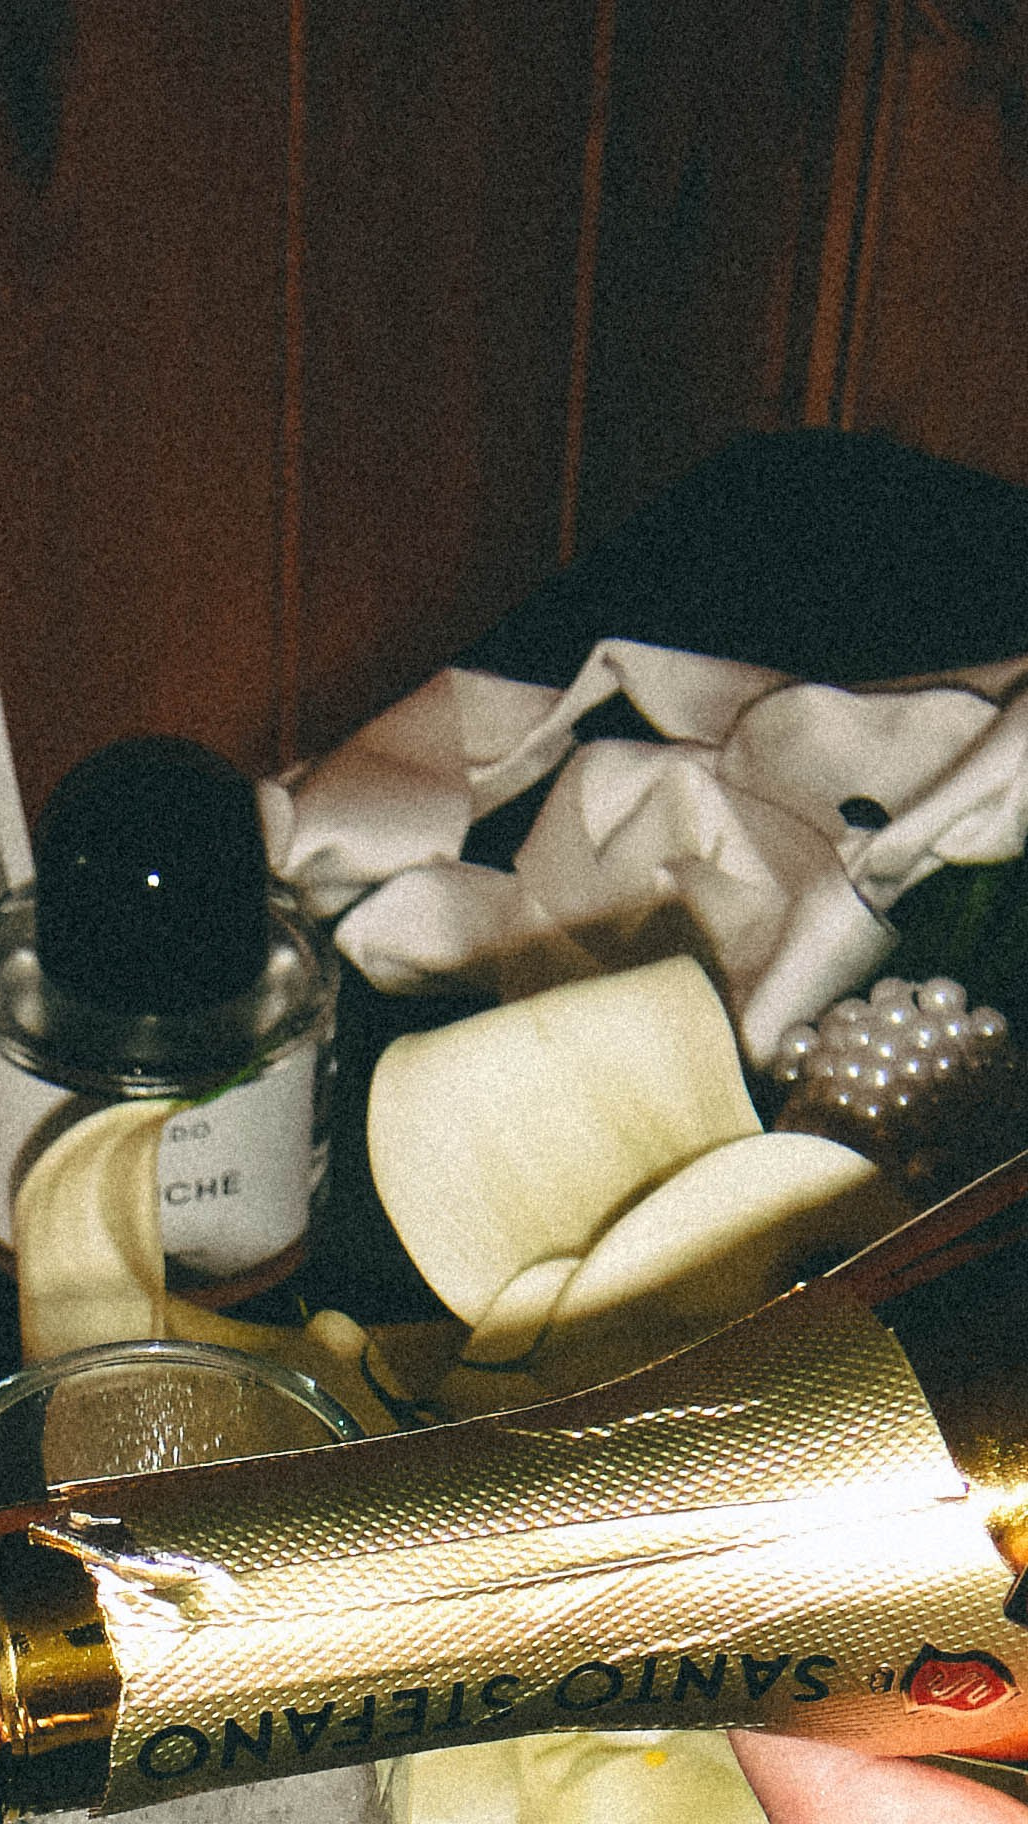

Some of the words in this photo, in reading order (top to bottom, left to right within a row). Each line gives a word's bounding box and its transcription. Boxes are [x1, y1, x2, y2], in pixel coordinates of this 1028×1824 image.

[169, 1120, 213, 1143] DO
[163, 1169, 243, 1208] CHE
[553, 1653, 838, 1711] SANTO
[136, 1673, 521, 1781] STEFANO
